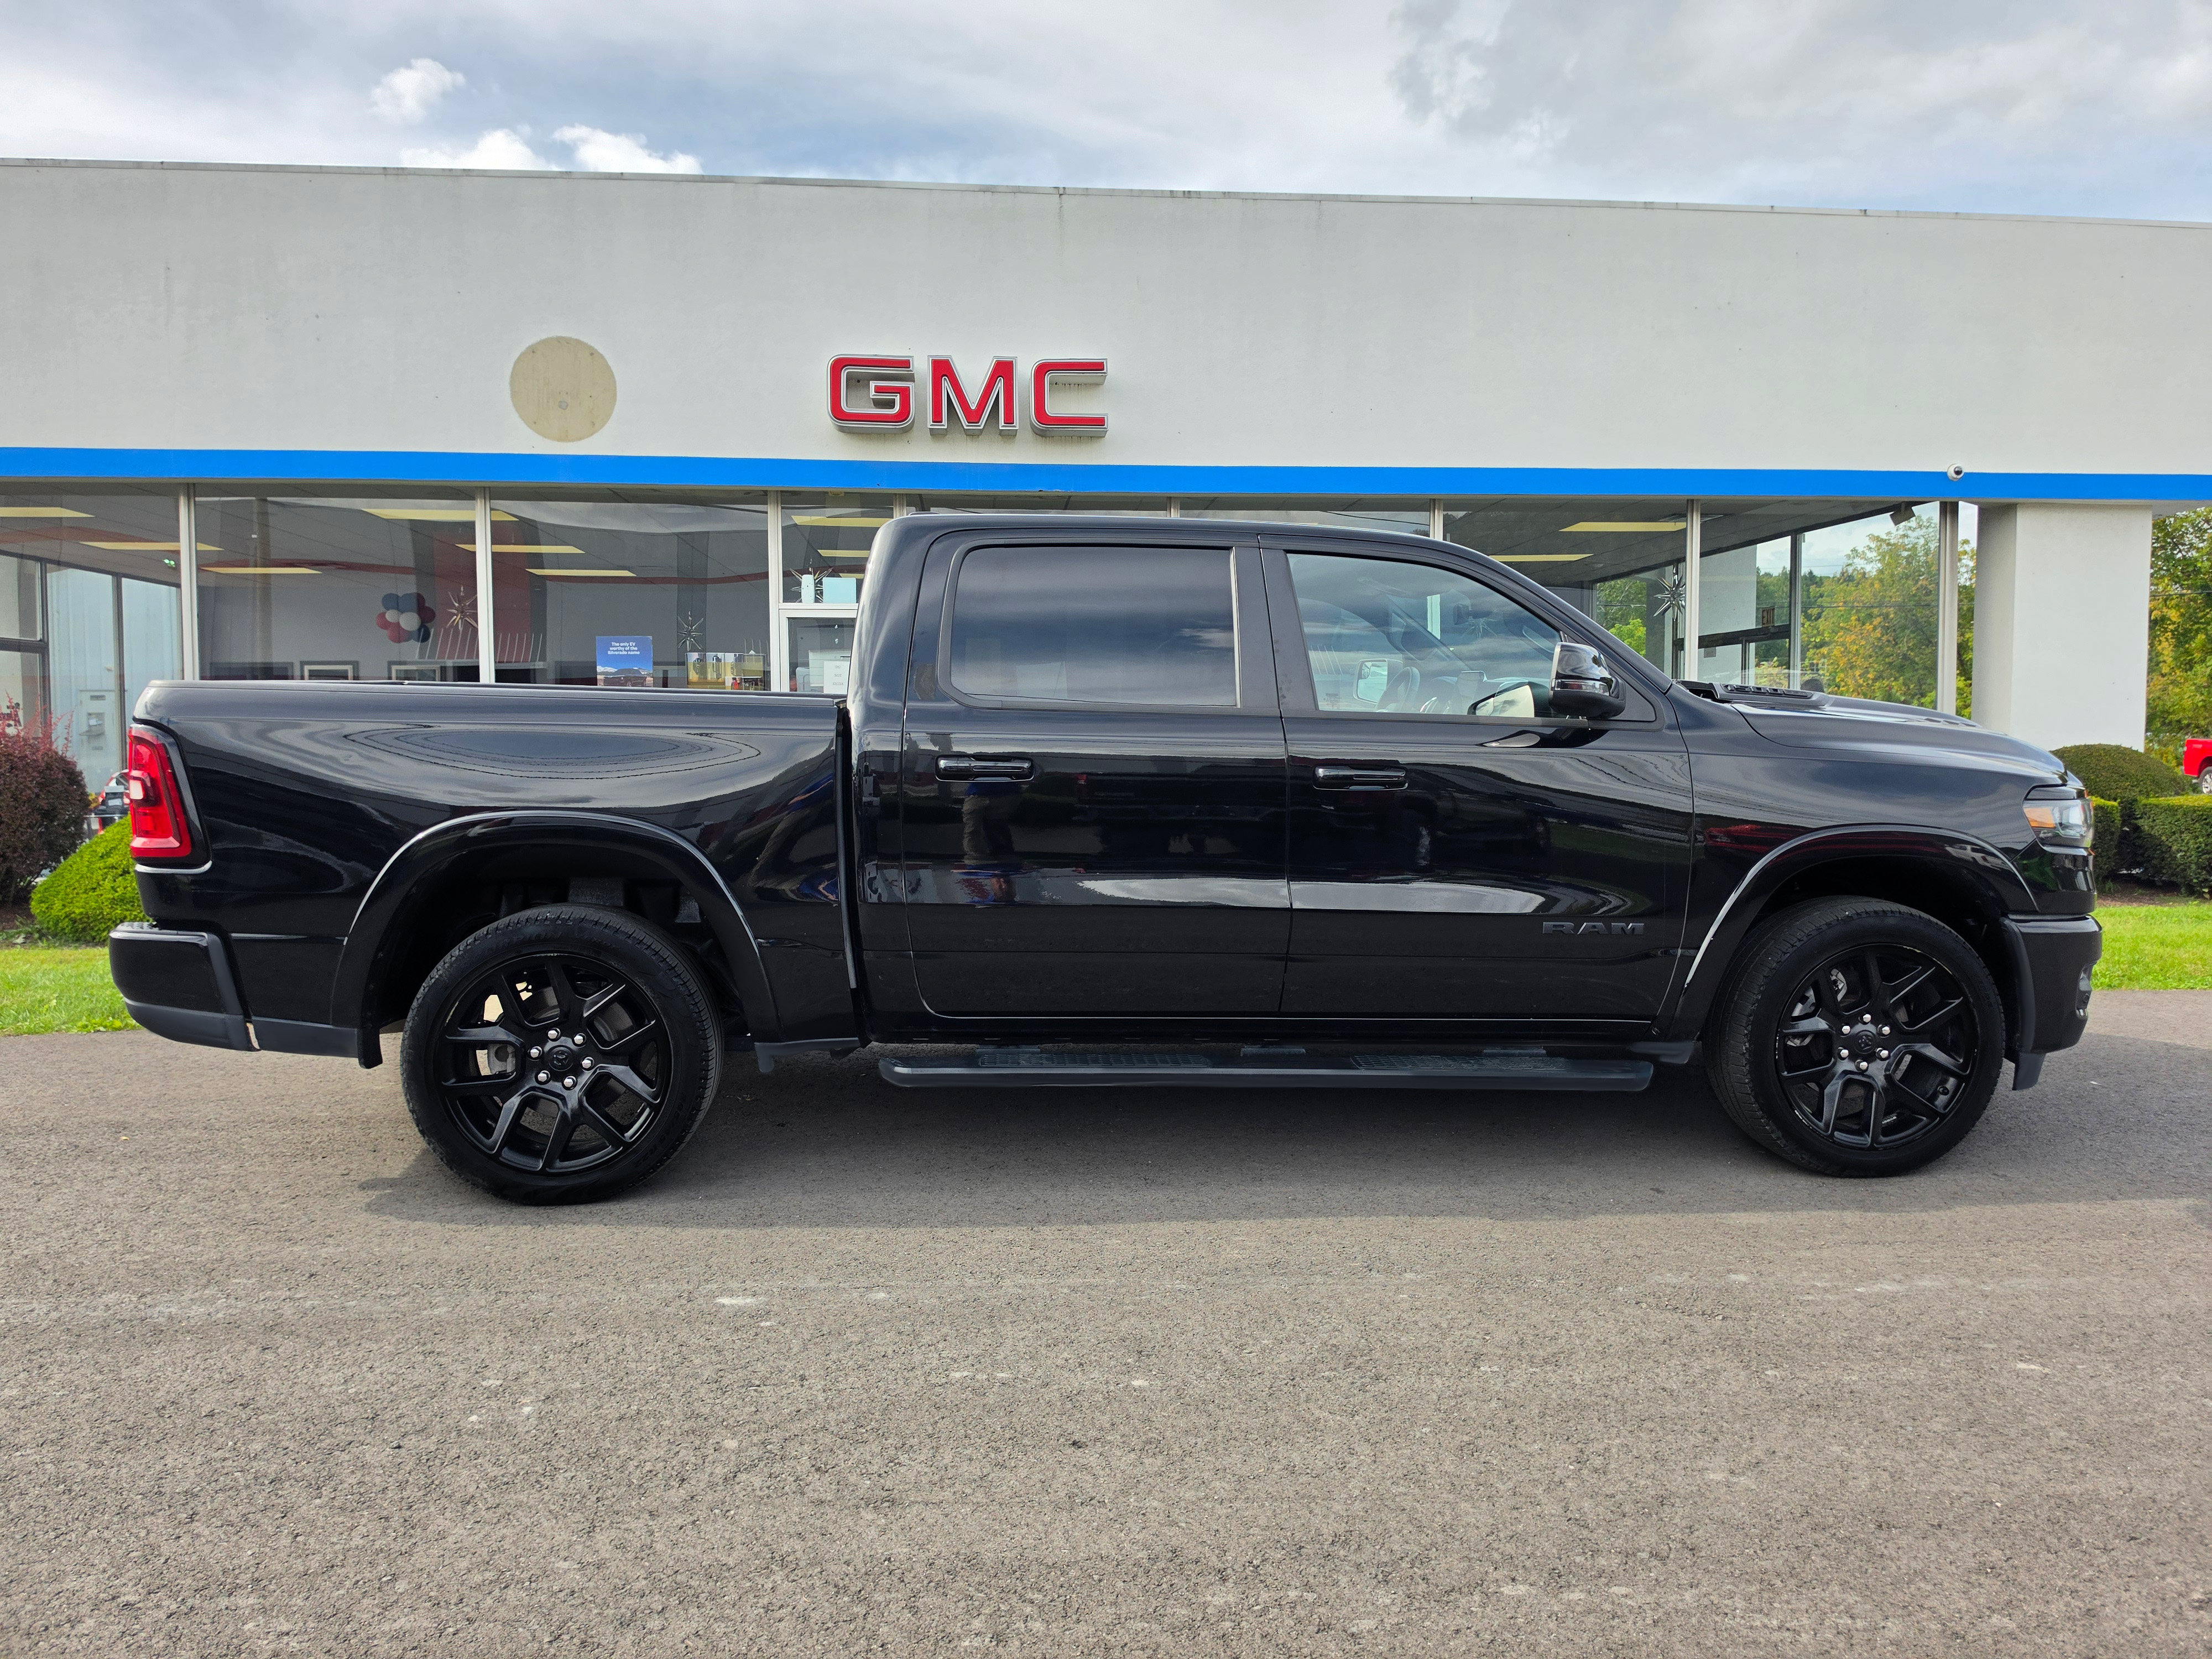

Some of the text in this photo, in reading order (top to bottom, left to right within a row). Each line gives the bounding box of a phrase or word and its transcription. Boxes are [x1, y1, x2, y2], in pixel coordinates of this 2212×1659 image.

[827, 354, 1108, 432] GMC
[1762, 608, 1775, 625] EXIT
[1542, 921, 1645, 935] RAM
